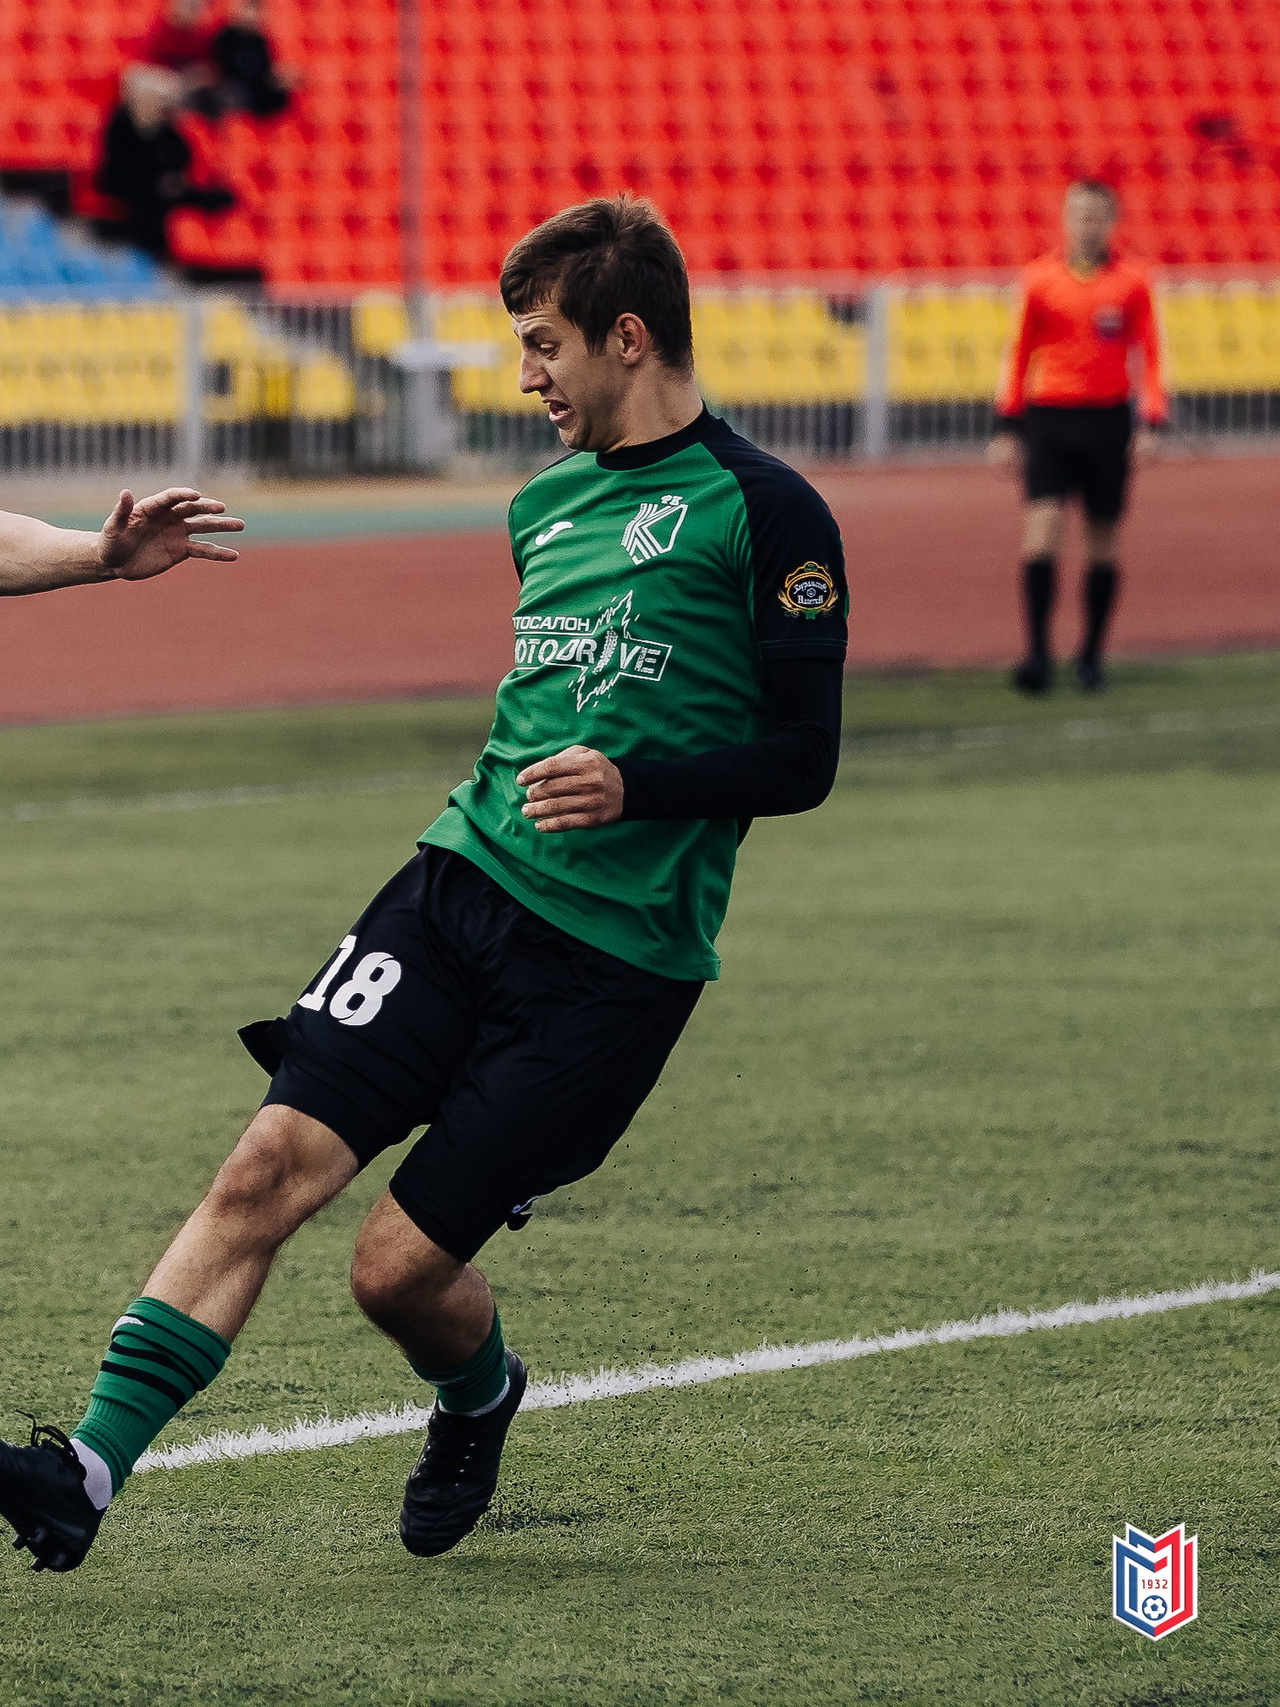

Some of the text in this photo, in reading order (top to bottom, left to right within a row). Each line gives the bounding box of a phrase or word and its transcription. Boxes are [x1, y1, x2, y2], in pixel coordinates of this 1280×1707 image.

[513, 616, 590, 631] ТОСАЛОН
[515, 627, 661, 676] OTODRIVE
[297, 934, 401, 1026] 18
